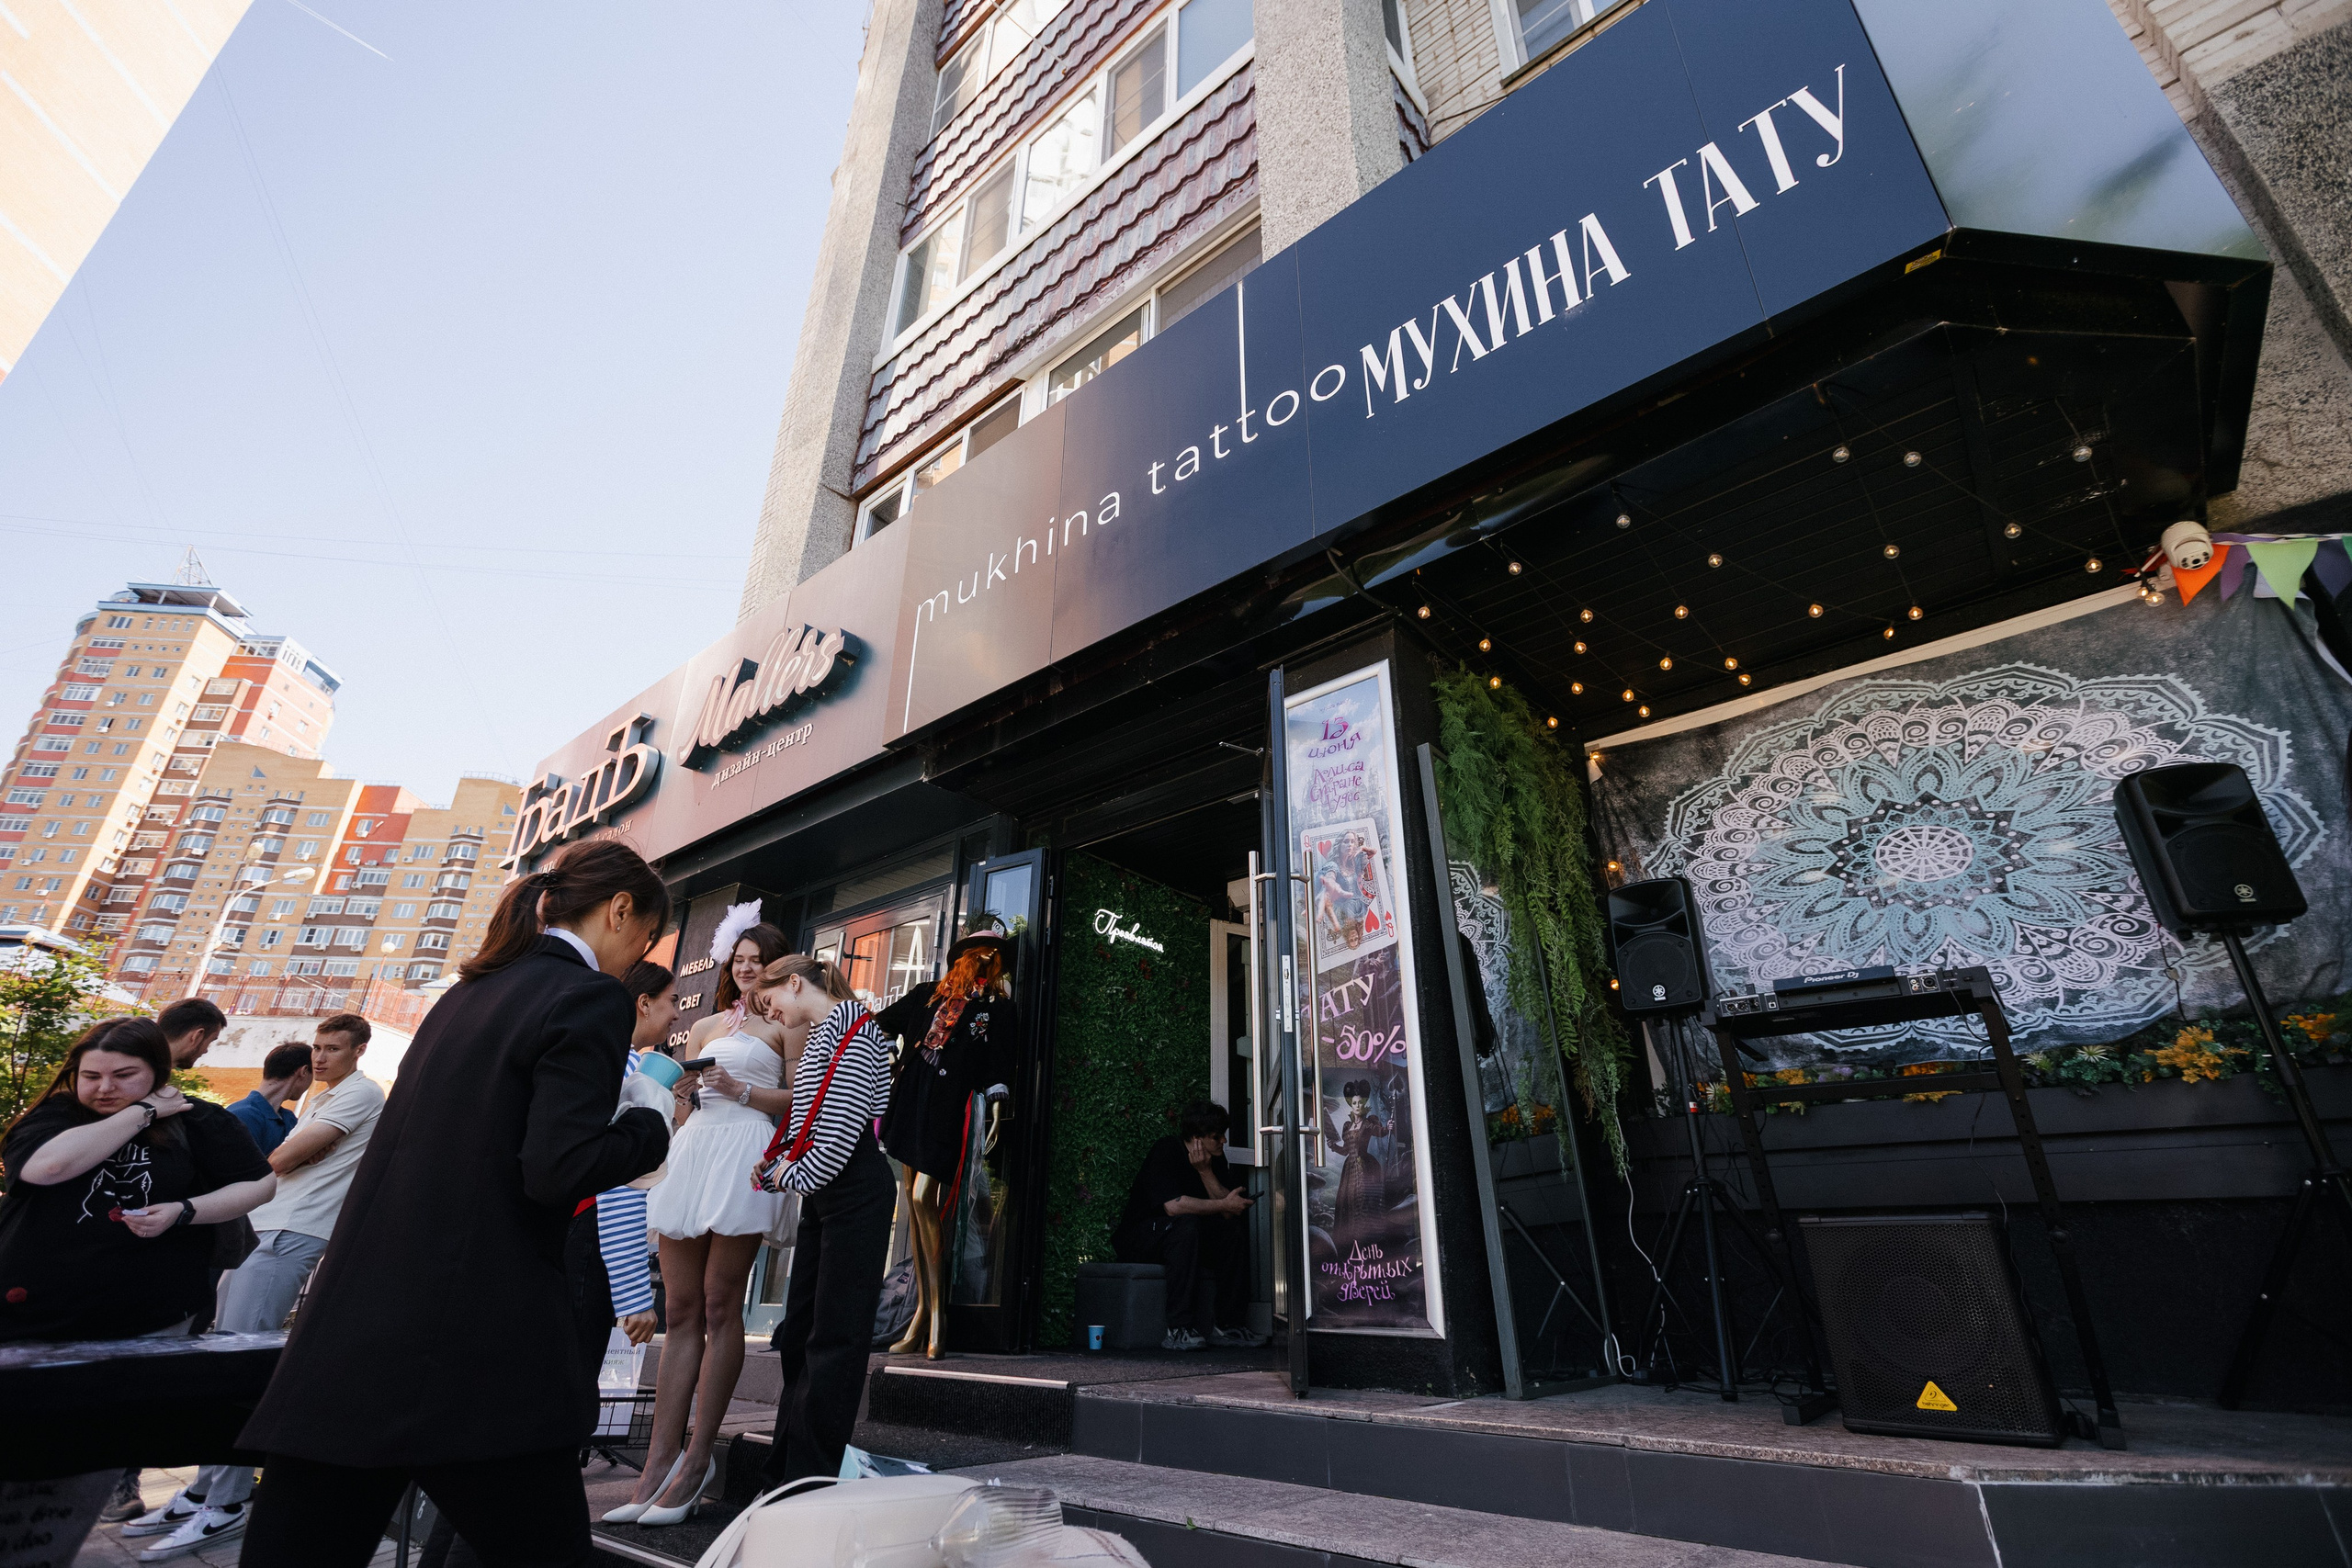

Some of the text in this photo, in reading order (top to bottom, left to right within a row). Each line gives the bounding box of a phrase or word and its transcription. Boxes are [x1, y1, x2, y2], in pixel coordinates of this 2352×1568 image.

[1360, 64, 1846, 418] МУХИНА ТАТУ
[1148, 282, 1346, 494] tattoo
[680, 624, 849, 766] Mallers
[1321, 716, 1349, 740] 13
[711, 723, 813, 789] дизайн-центр
[1308, 732, 1361, 758] июня
[1314, 761, 1364, 784] Алиса
[1320, 791, 1360, 813] Чудес
[680, 957, 714, 977] МЕБЕЛЬ
[1804, 974, 1845, 984] Pioneer
[680, 993, 702, 1010] СВЕТ
[669, 1030, 690, 1047] ОБО
[1321, 1024, 1407, 1063] -50%
[1347, 1239, 1384, 1267] День
[1321, 1256, 1413, 1283] открытых
[1337, 1280, 1396, 1306] дверей
